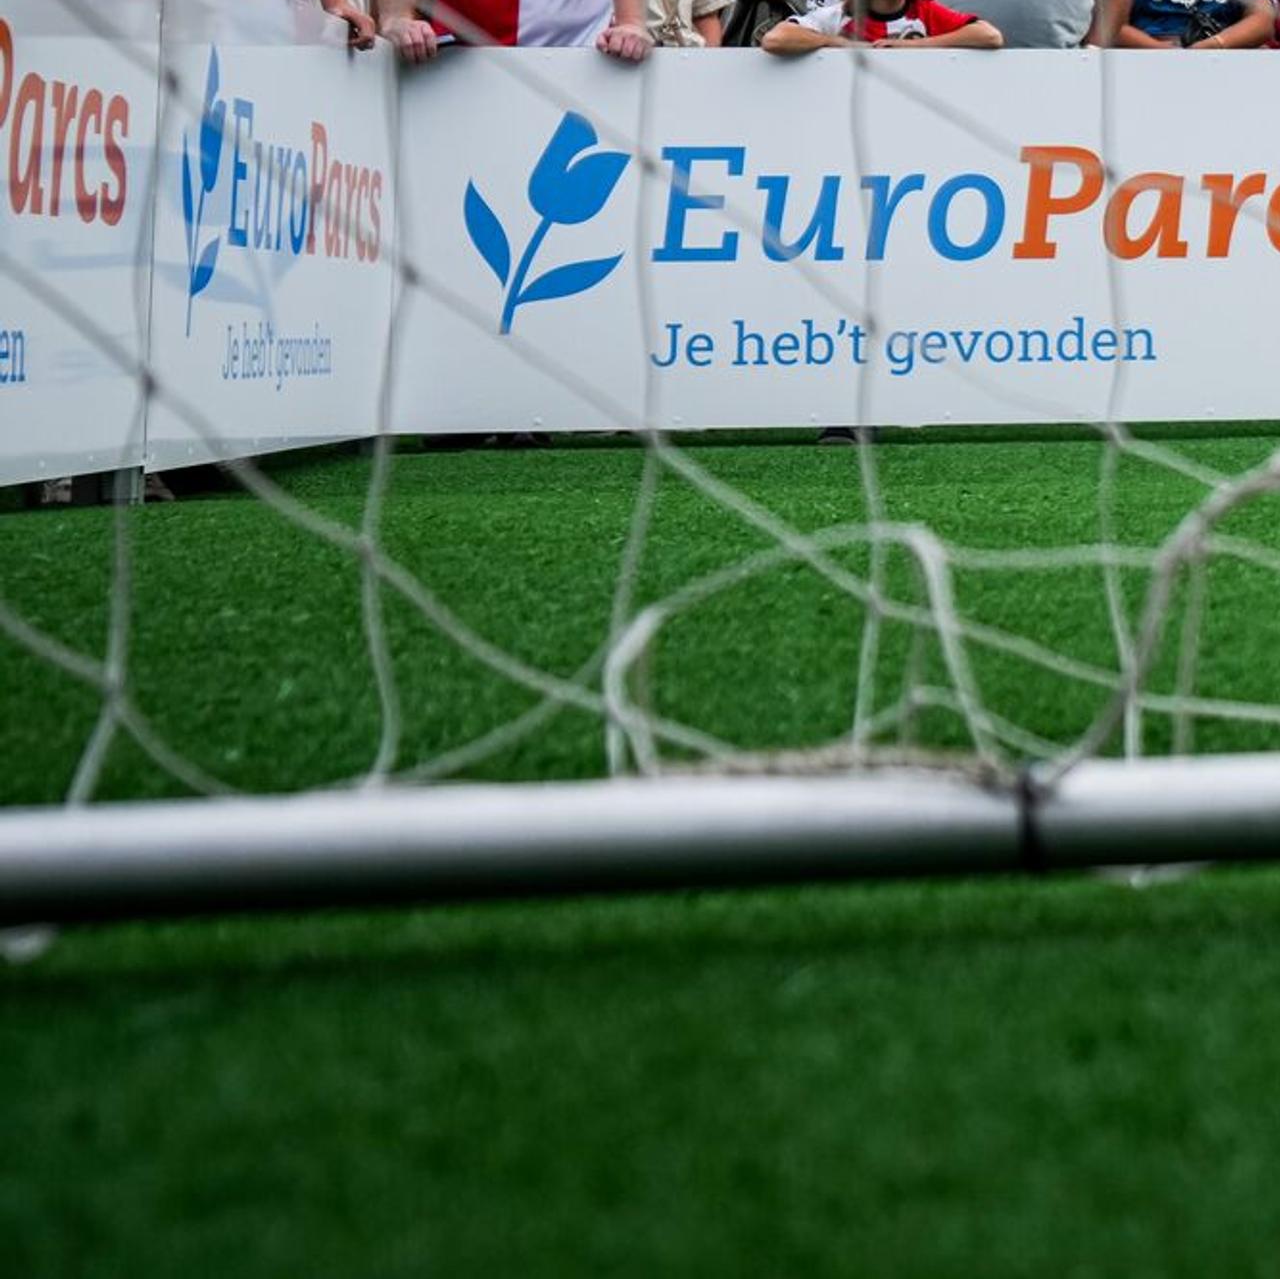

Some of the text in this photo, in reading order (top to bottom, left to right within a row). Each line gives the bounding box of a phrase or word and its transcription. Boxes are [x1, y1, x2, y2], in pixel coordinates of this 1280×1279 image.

[228, 98, 384, 263] EuroParcs
[222, 324, 240, 380] Je
[651, 316, 1157, 378] Je heb't gevonden
